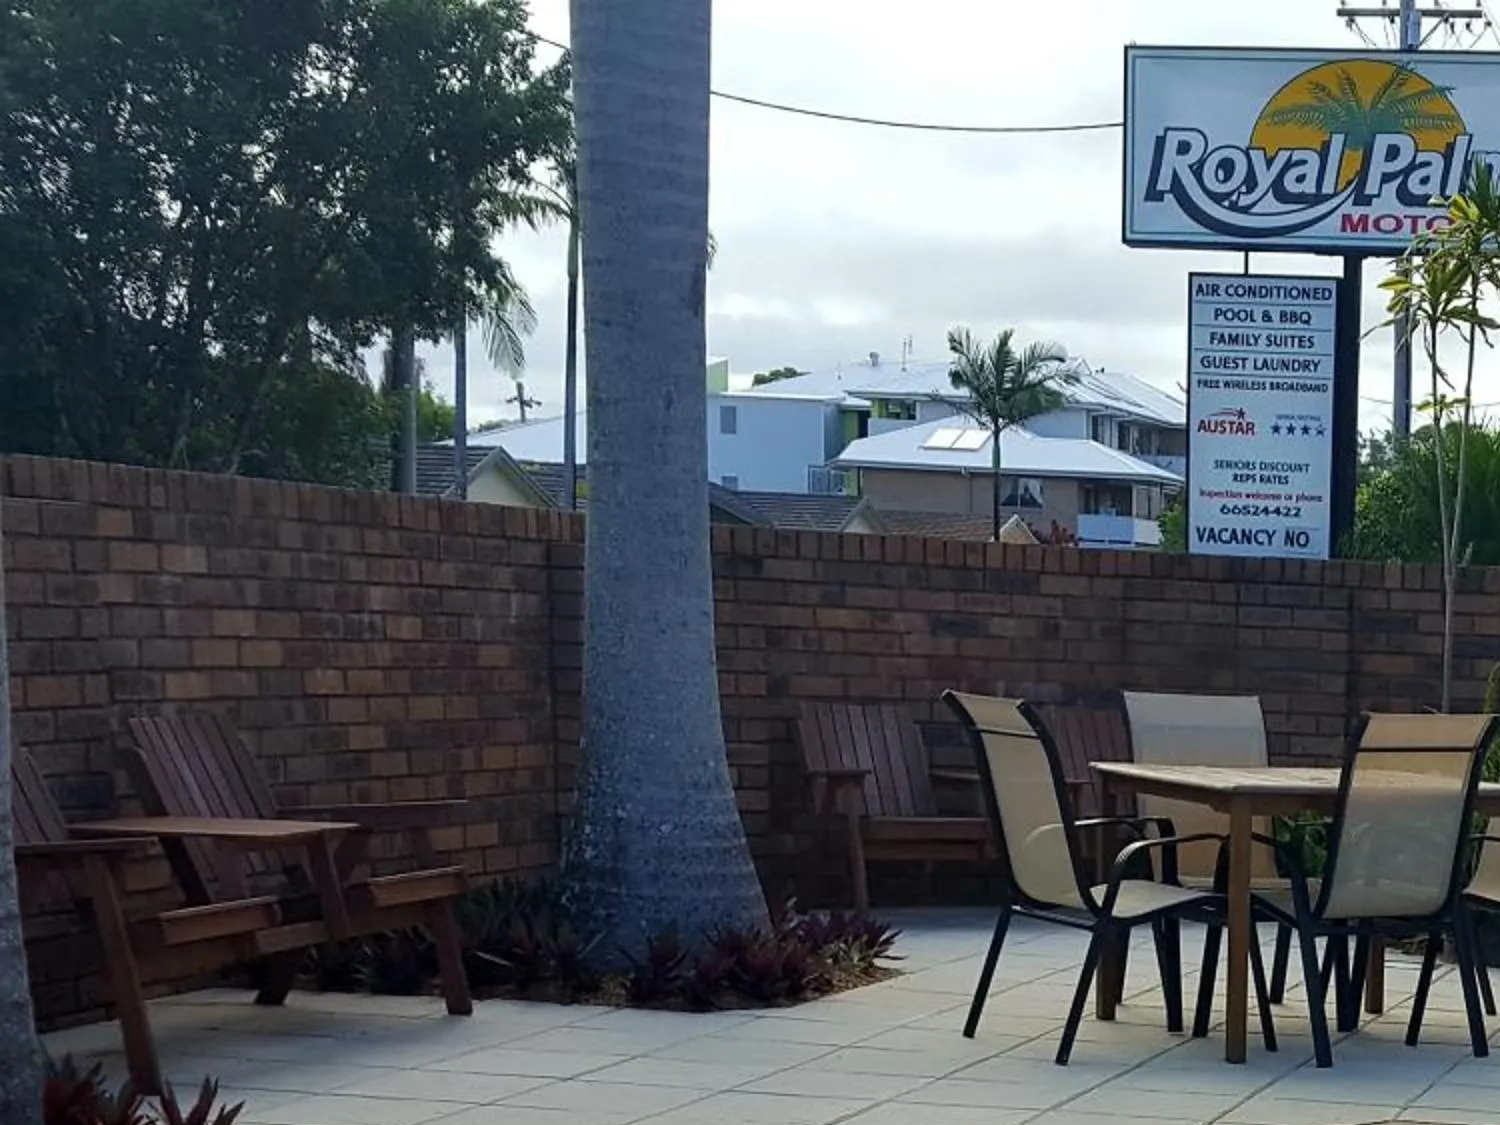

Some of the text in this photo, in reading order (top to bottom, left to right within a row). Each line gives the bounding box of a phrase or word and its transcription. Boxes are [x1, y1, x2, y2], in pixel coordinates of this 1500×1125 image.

[1144, 127, 1357, 234] Royal
[1340, 213, 1462, 238] MOTO
[1195, 283, 1333, 300] AIR CONDITIONED
[1213, 308, 1313, 326] POOL & BBQ
[1209, 331, 1315, 349] FAMILY SUITES
[1200, 355, 1321, 373] GUEST LAUNDRY
[1197, 378, 1329, 393] FREE WIRELESS BROADBAND
[1197, 419, 1256, 436] AUSTAR
[1213, 459, 1311, 473] SENIORS DISCOUNT
[1231, 473, 1290, 485] REPS RATES
[1219, 503, 1302, 518] 66524422
[1195, 526, 1311, 549] VACANCY NO
